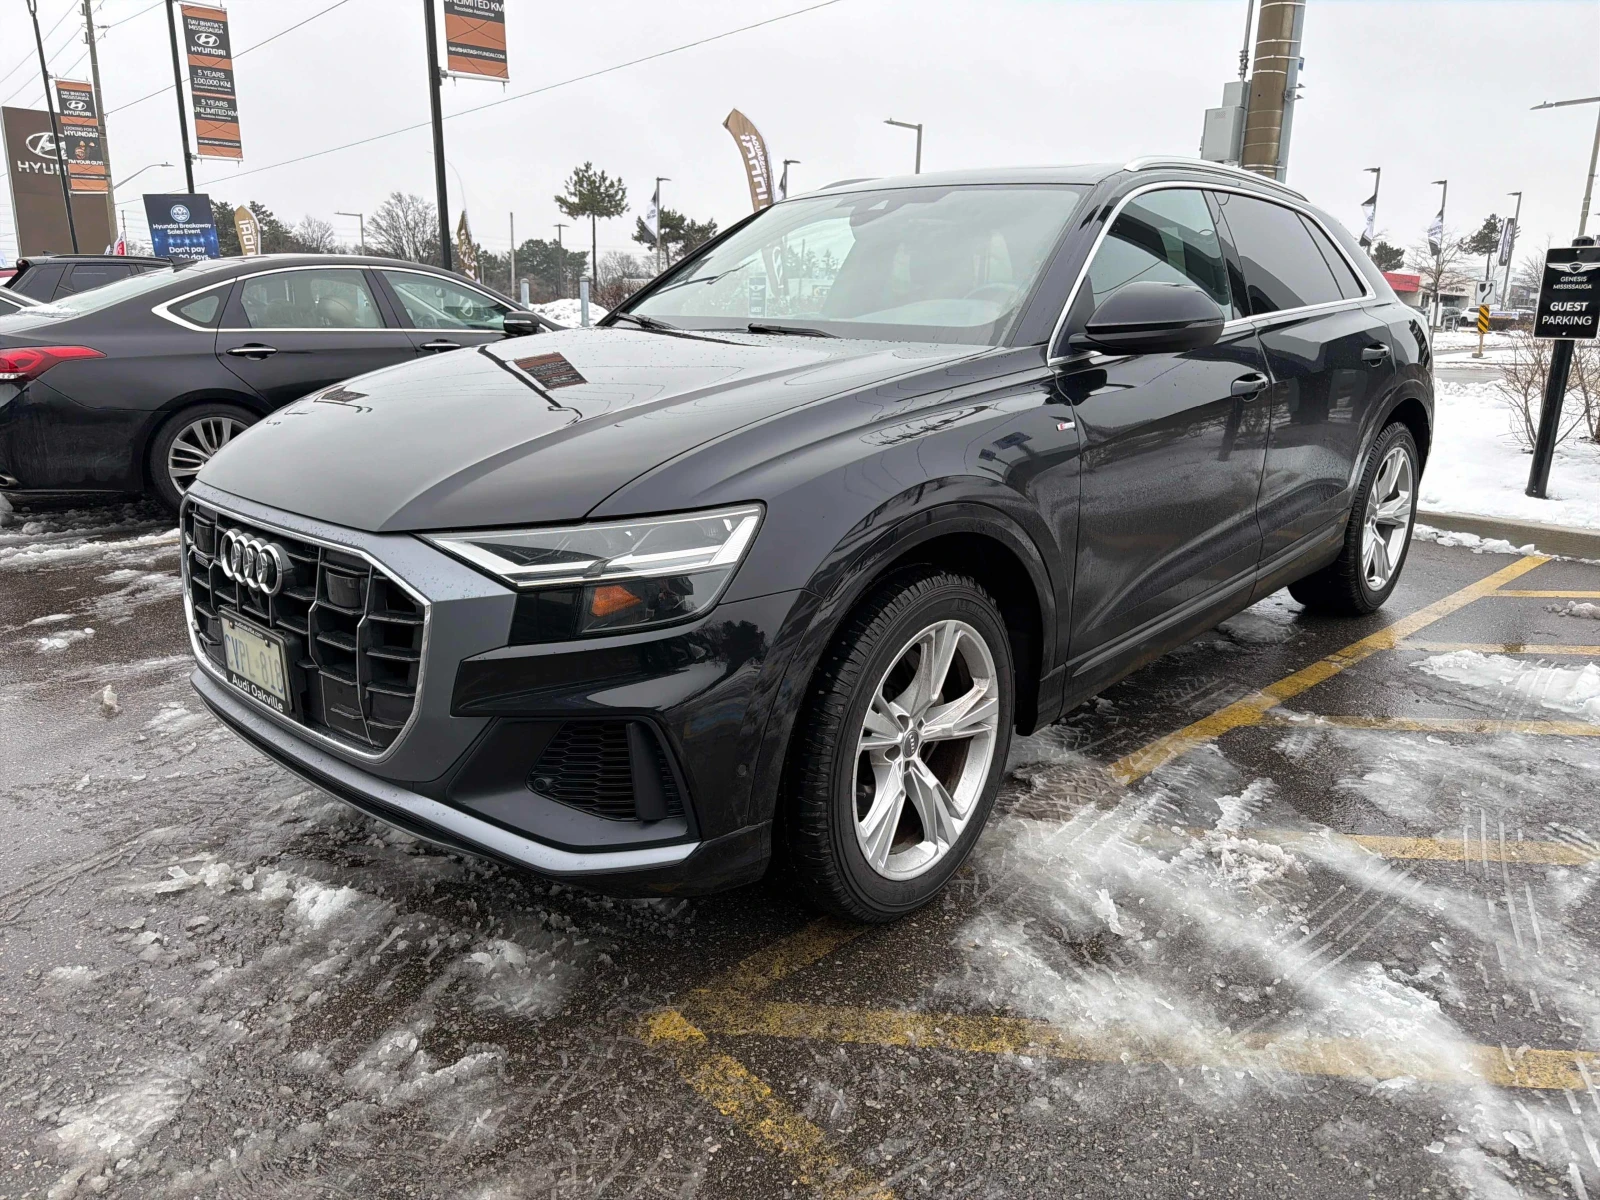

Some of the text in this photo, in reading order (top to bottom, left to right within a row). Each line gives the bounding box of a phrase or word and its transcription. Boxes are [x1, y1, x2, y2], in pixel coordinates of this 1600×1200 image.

[191, 45, 226, 56] HYUNDAI
[203, 70, 225, 78] YEARS
[193, 77, 220, 86] 100,000
[206, 99, 229, 108] YEARS
[64, 130, 99, 138] HYUNDAI?
[179, 222, 212, 230] Breakaway
[169, 246, 206, 254] Don't pay
[1549, 301, 1589, 312] GUEST
[1541, 315, 1592, 326] PARKING
[232, 673, 284, 713] Audi Oakville
